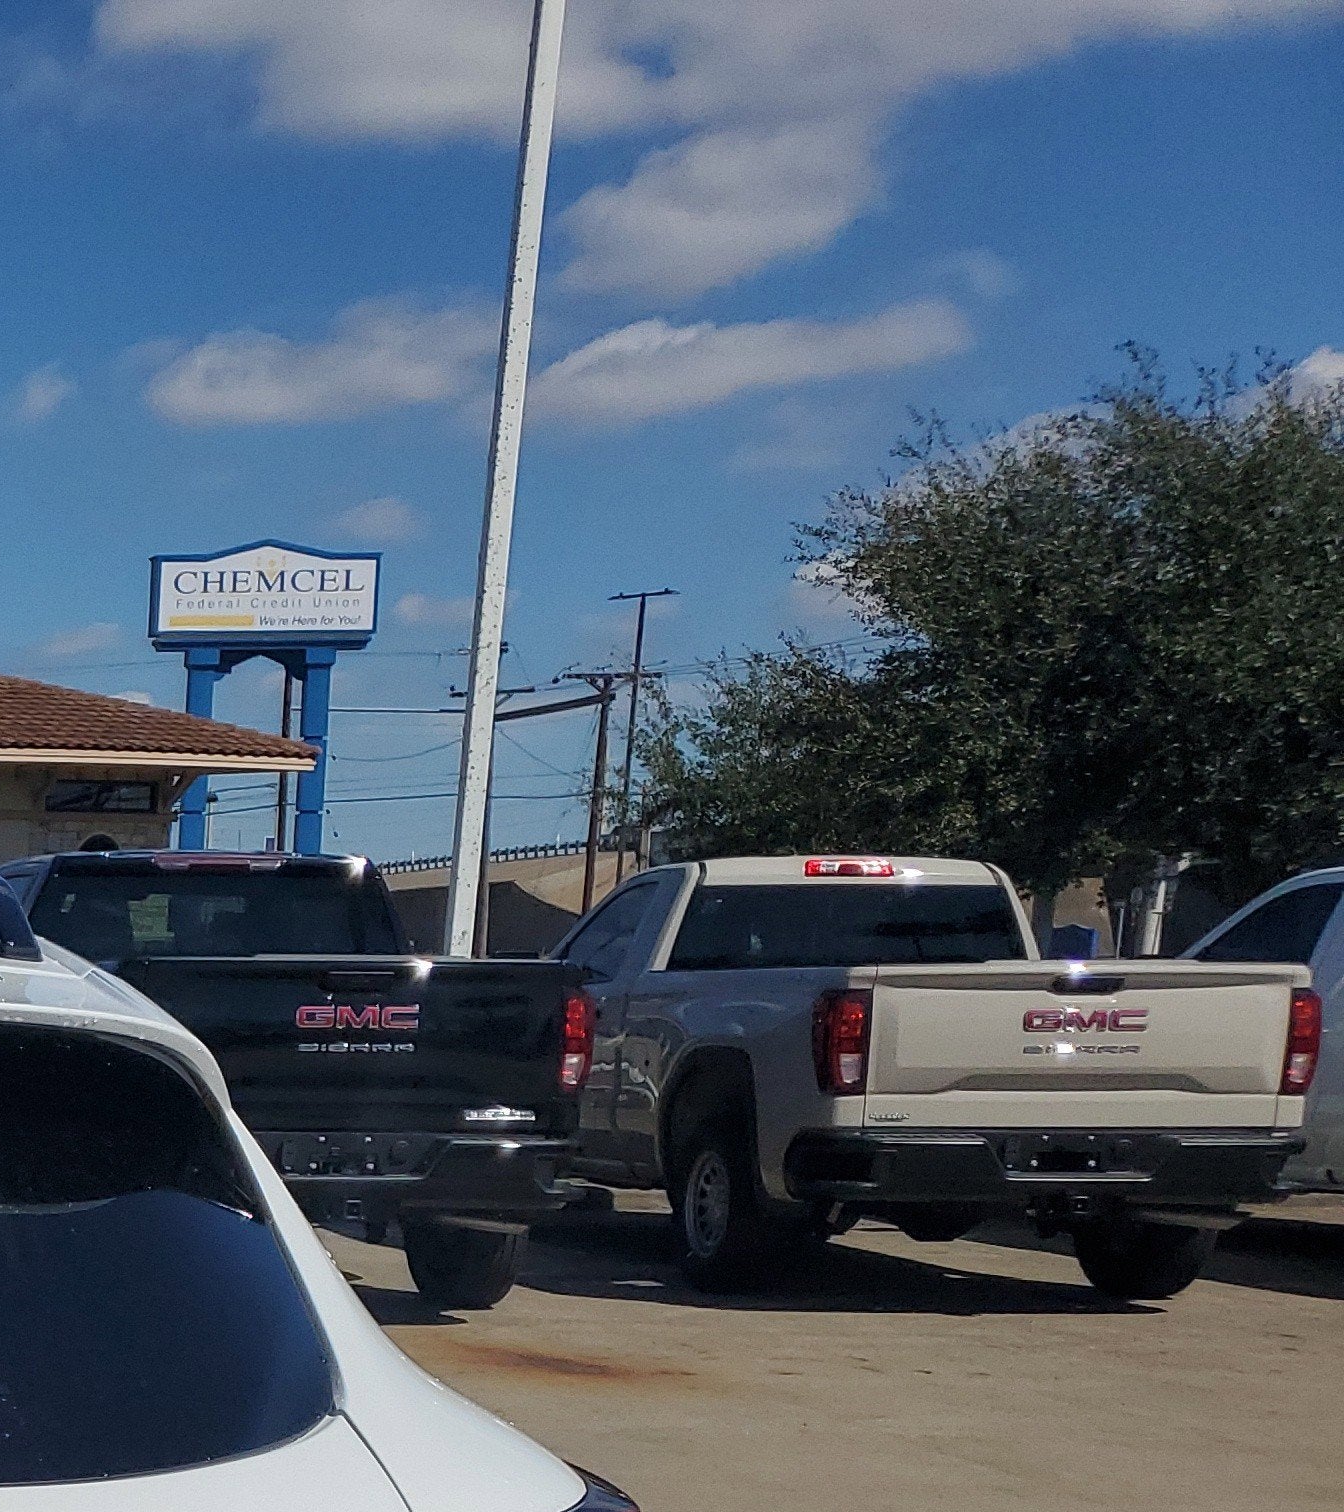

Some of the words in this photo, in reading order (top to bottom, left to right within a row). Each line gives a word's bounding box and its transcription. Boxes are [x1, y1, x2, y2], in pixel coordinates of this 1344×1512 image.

[173, 568, 365, 595] CHEMCEL
[175, 598, 241, 610] Federal
[250, 598, 302, 609] Credit
[313, 597, 361, 609] Union
[292, 615, 317, 626] Here
[319, 615, 333, 626] for
[295, 1004, 420, 1029] GMC
[1023, 1008, 1149, 1032] GMC
